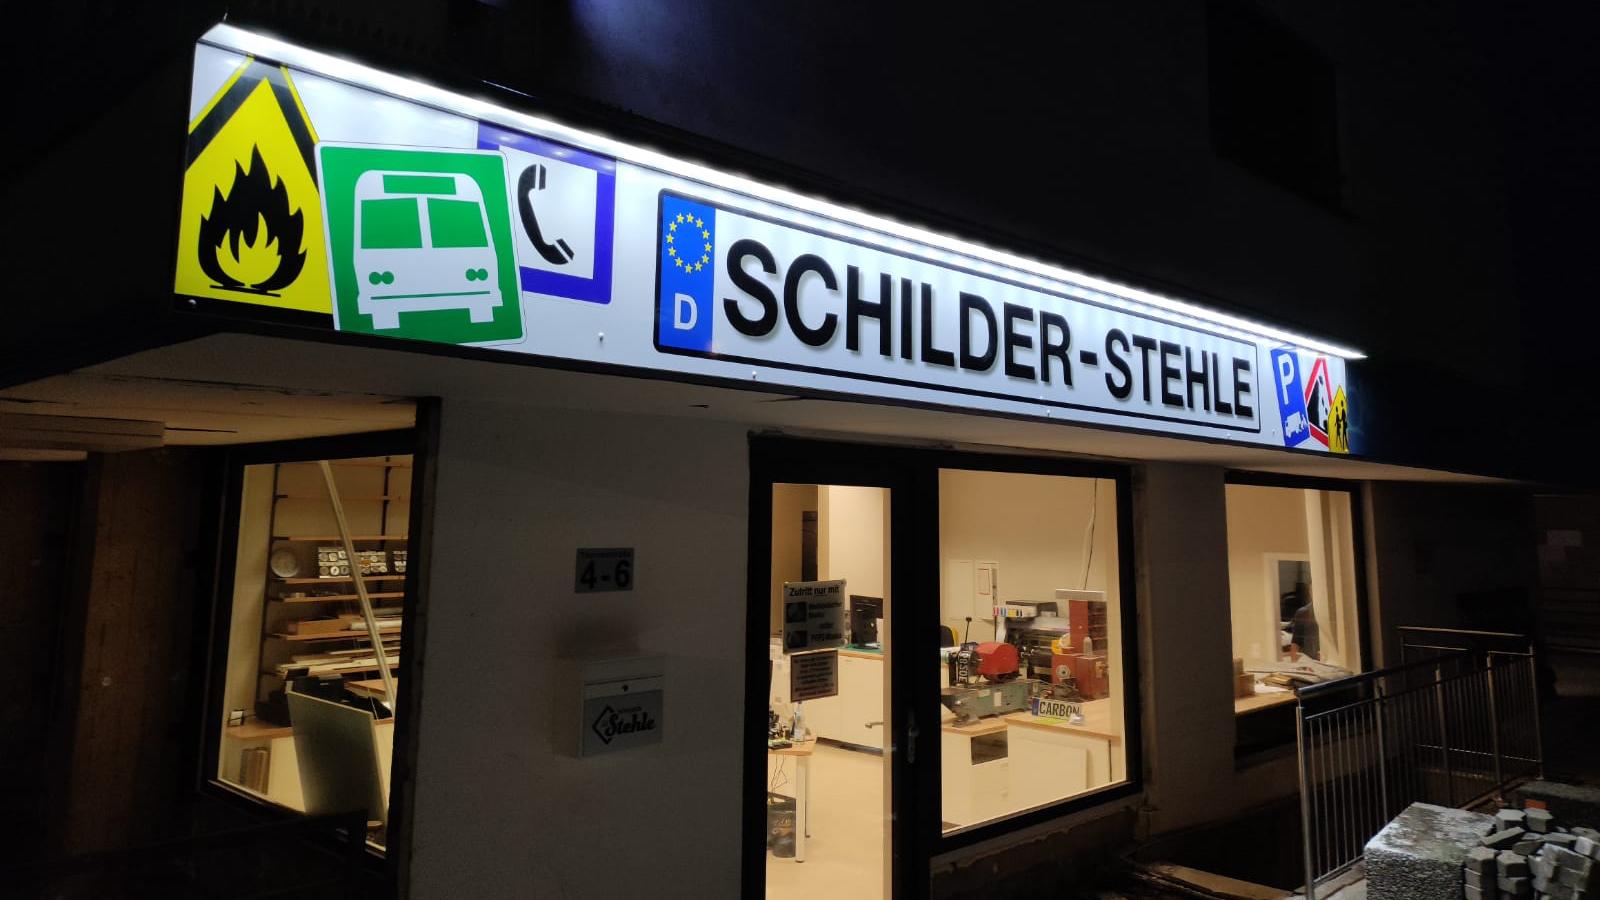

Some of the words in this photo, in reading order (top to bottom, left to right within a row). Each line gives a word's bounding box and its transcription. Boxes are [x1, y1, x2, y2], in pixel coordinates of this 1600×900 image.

[673, 293, 698, 330] D
[723, 238, 1253, 418] SCHILDER-STEHLE
[1278, 353, 1295, 405] P
[604, 711, 655, 737] Stehle
[1039, 701, 1080, 717] CARBON
